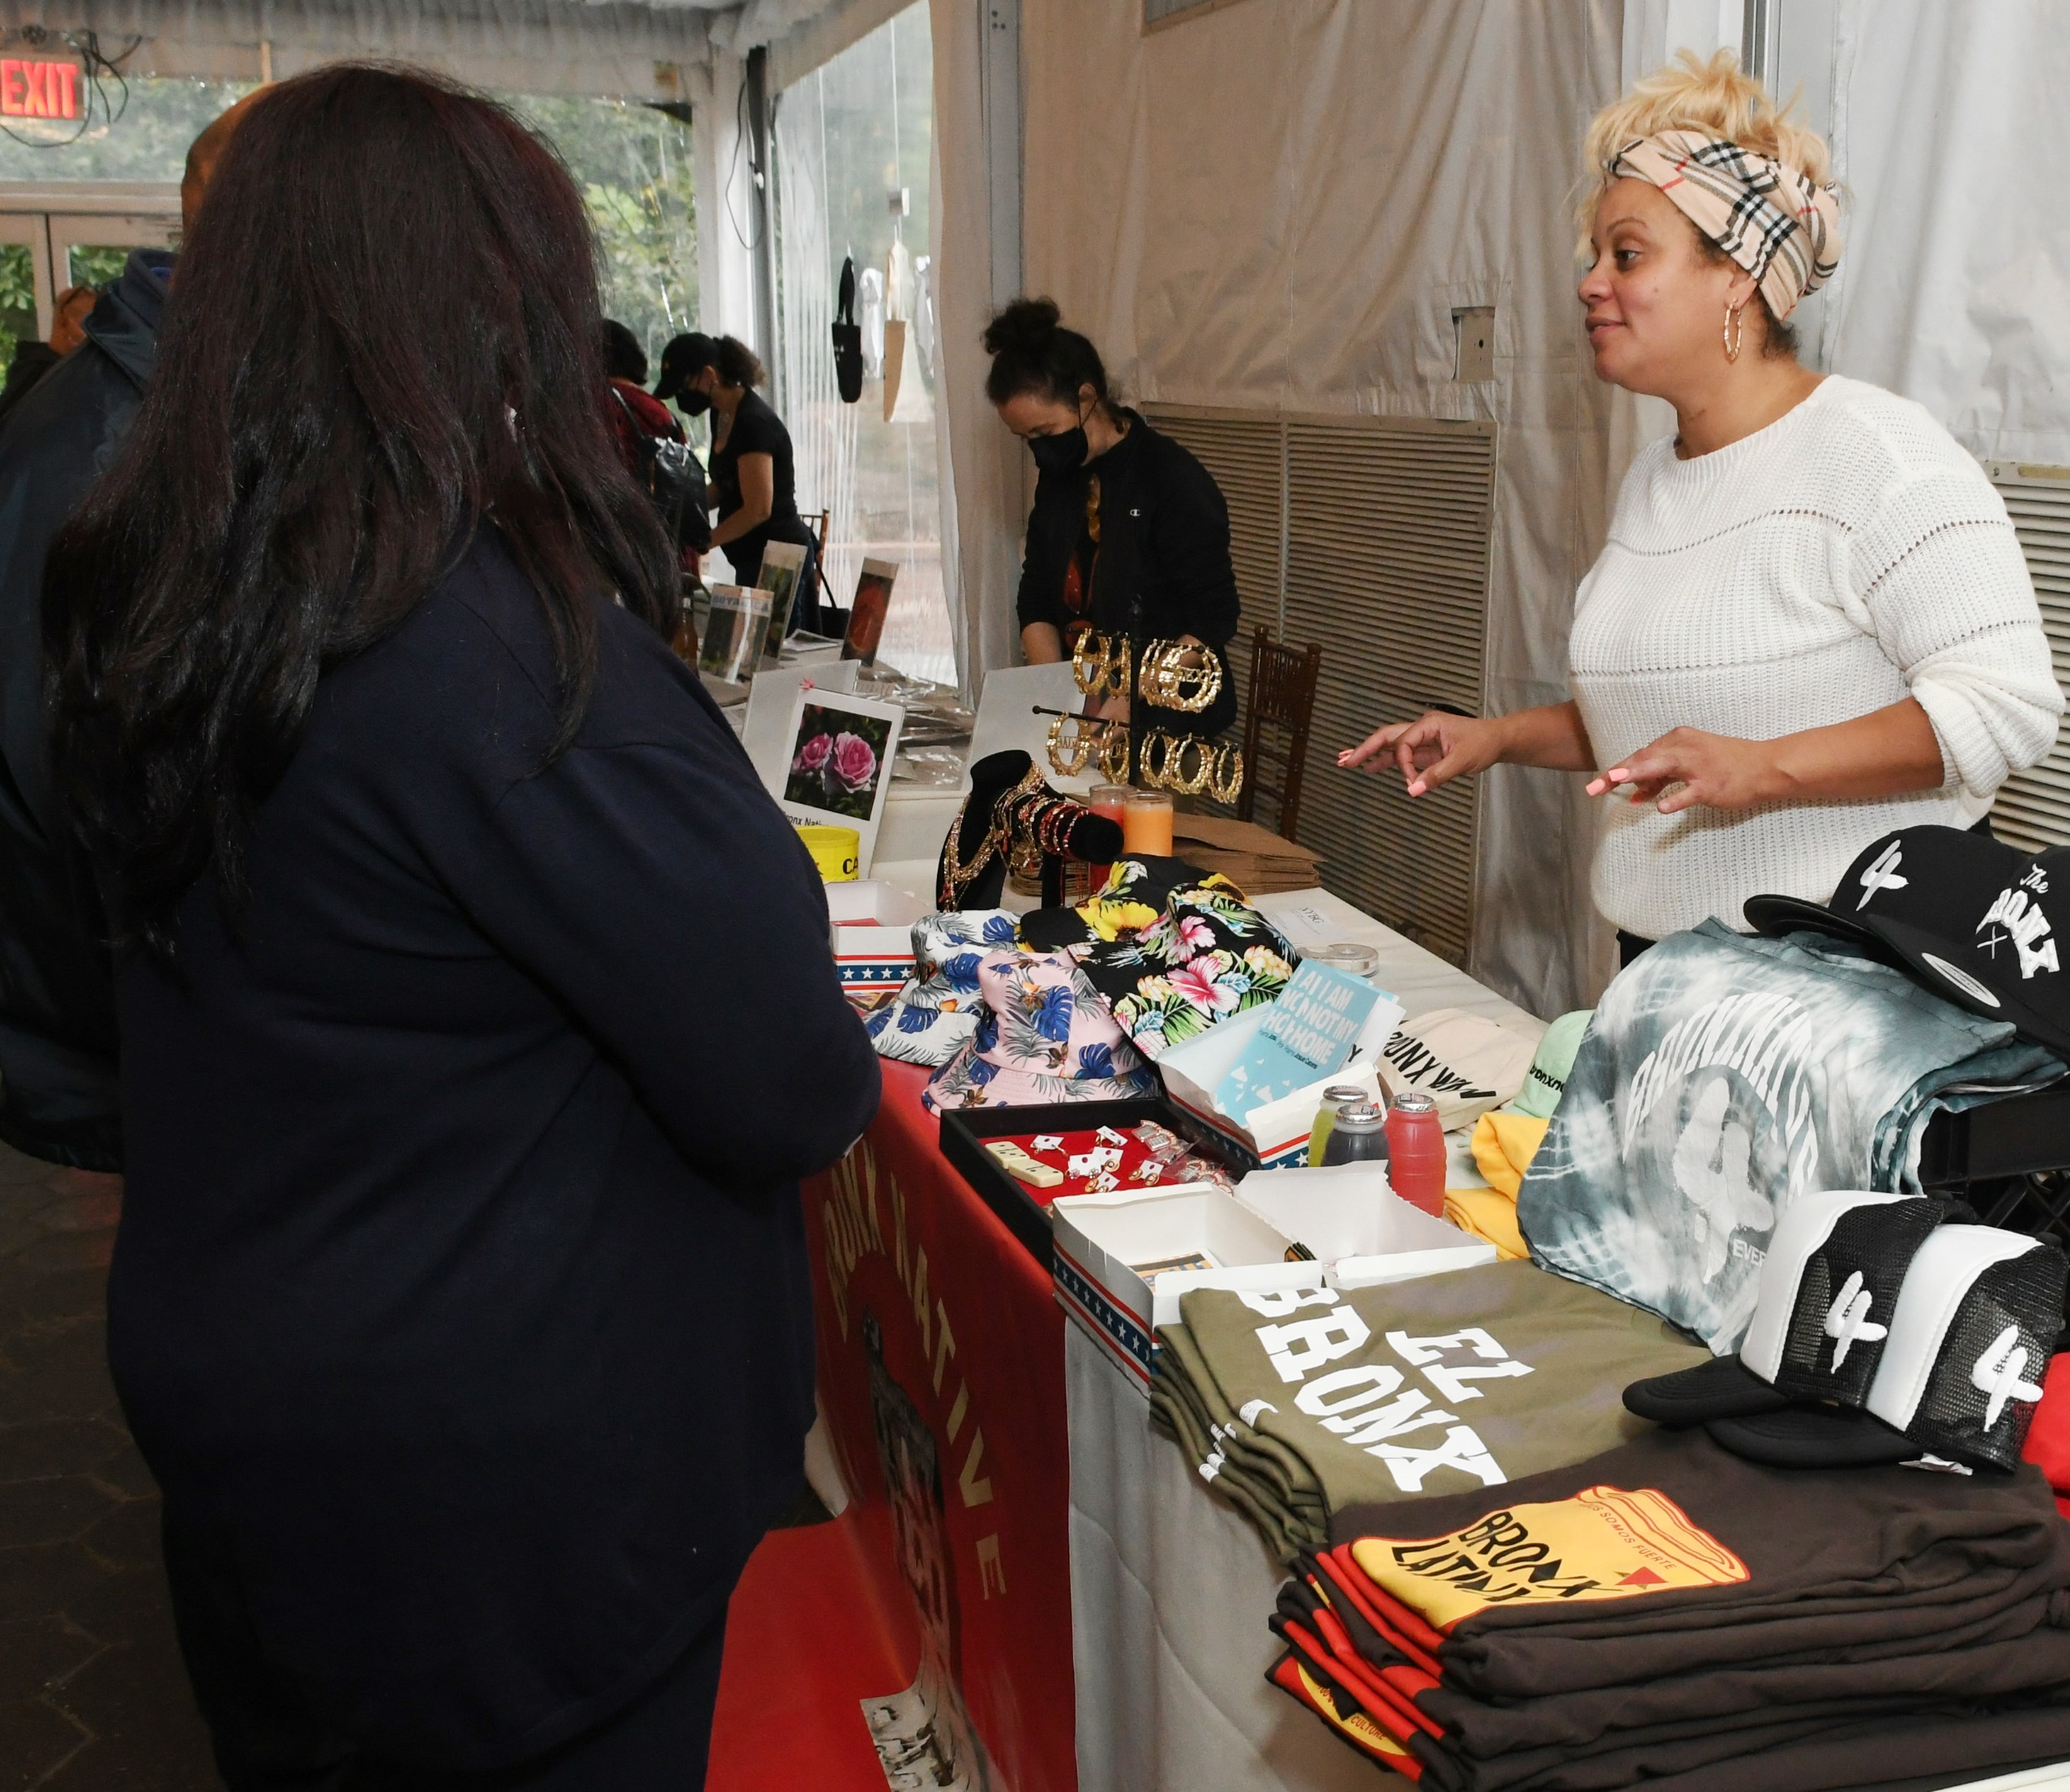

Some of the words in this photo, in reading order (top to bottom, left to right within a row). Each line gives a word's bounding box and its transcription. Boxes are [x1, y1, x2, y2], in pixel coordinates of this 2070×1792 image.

[1, 58, 78, 119] EXIT
[1855, 839, 1910, 912] 4
[2019, 862, 2049, 894] The
[1287, 1024, 1337, 1064] HOME
[1824, 1270, 1888, 1375] 4
[1234, 1287, 1509, 1493] BRONX
[1969, 1324, 2044, 1433] 4
[1458, 1511, 1623, 1598] BRONX
[1599, 1512, 1636, 1544] SOMOS
[1632, 1544, 1678, 1570] FUERTE
[1350, 1715, 1387, 1741] CULTURE
